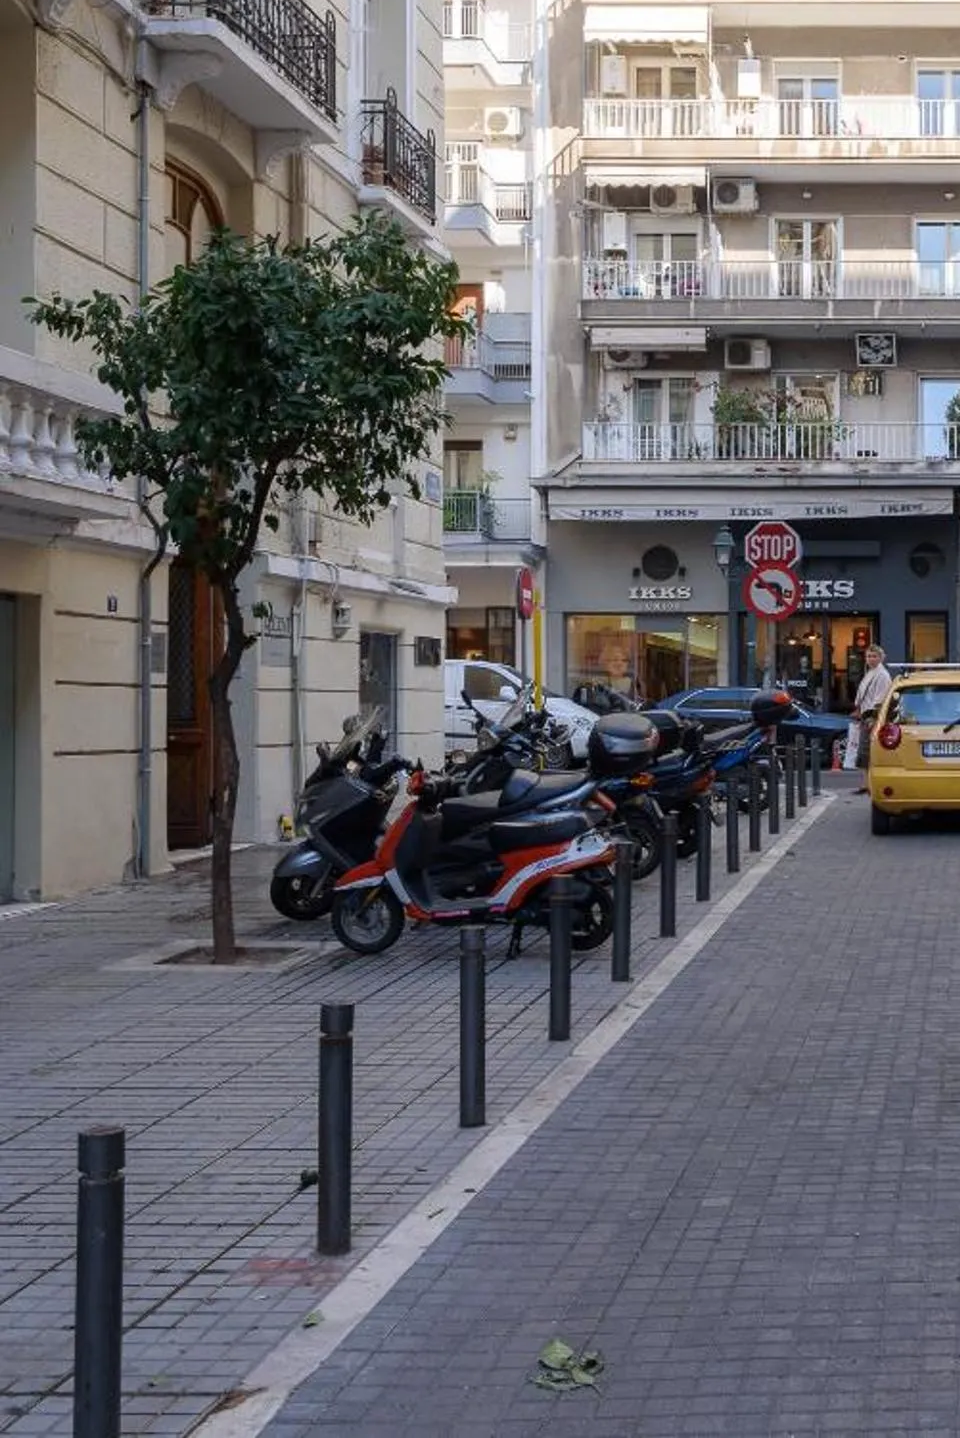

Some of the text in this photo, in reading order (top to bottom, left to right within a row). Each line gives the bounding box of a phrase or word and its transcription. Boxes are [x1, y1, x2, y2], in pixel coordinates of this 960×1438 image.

[580, 503, 924, 518] IKKS IKKS IKKS IKKS IKKS
[750, 534, 795, 561] STOP
[628, 585, 692, 600] IKKS
[799, 580, 855, 598] KS
